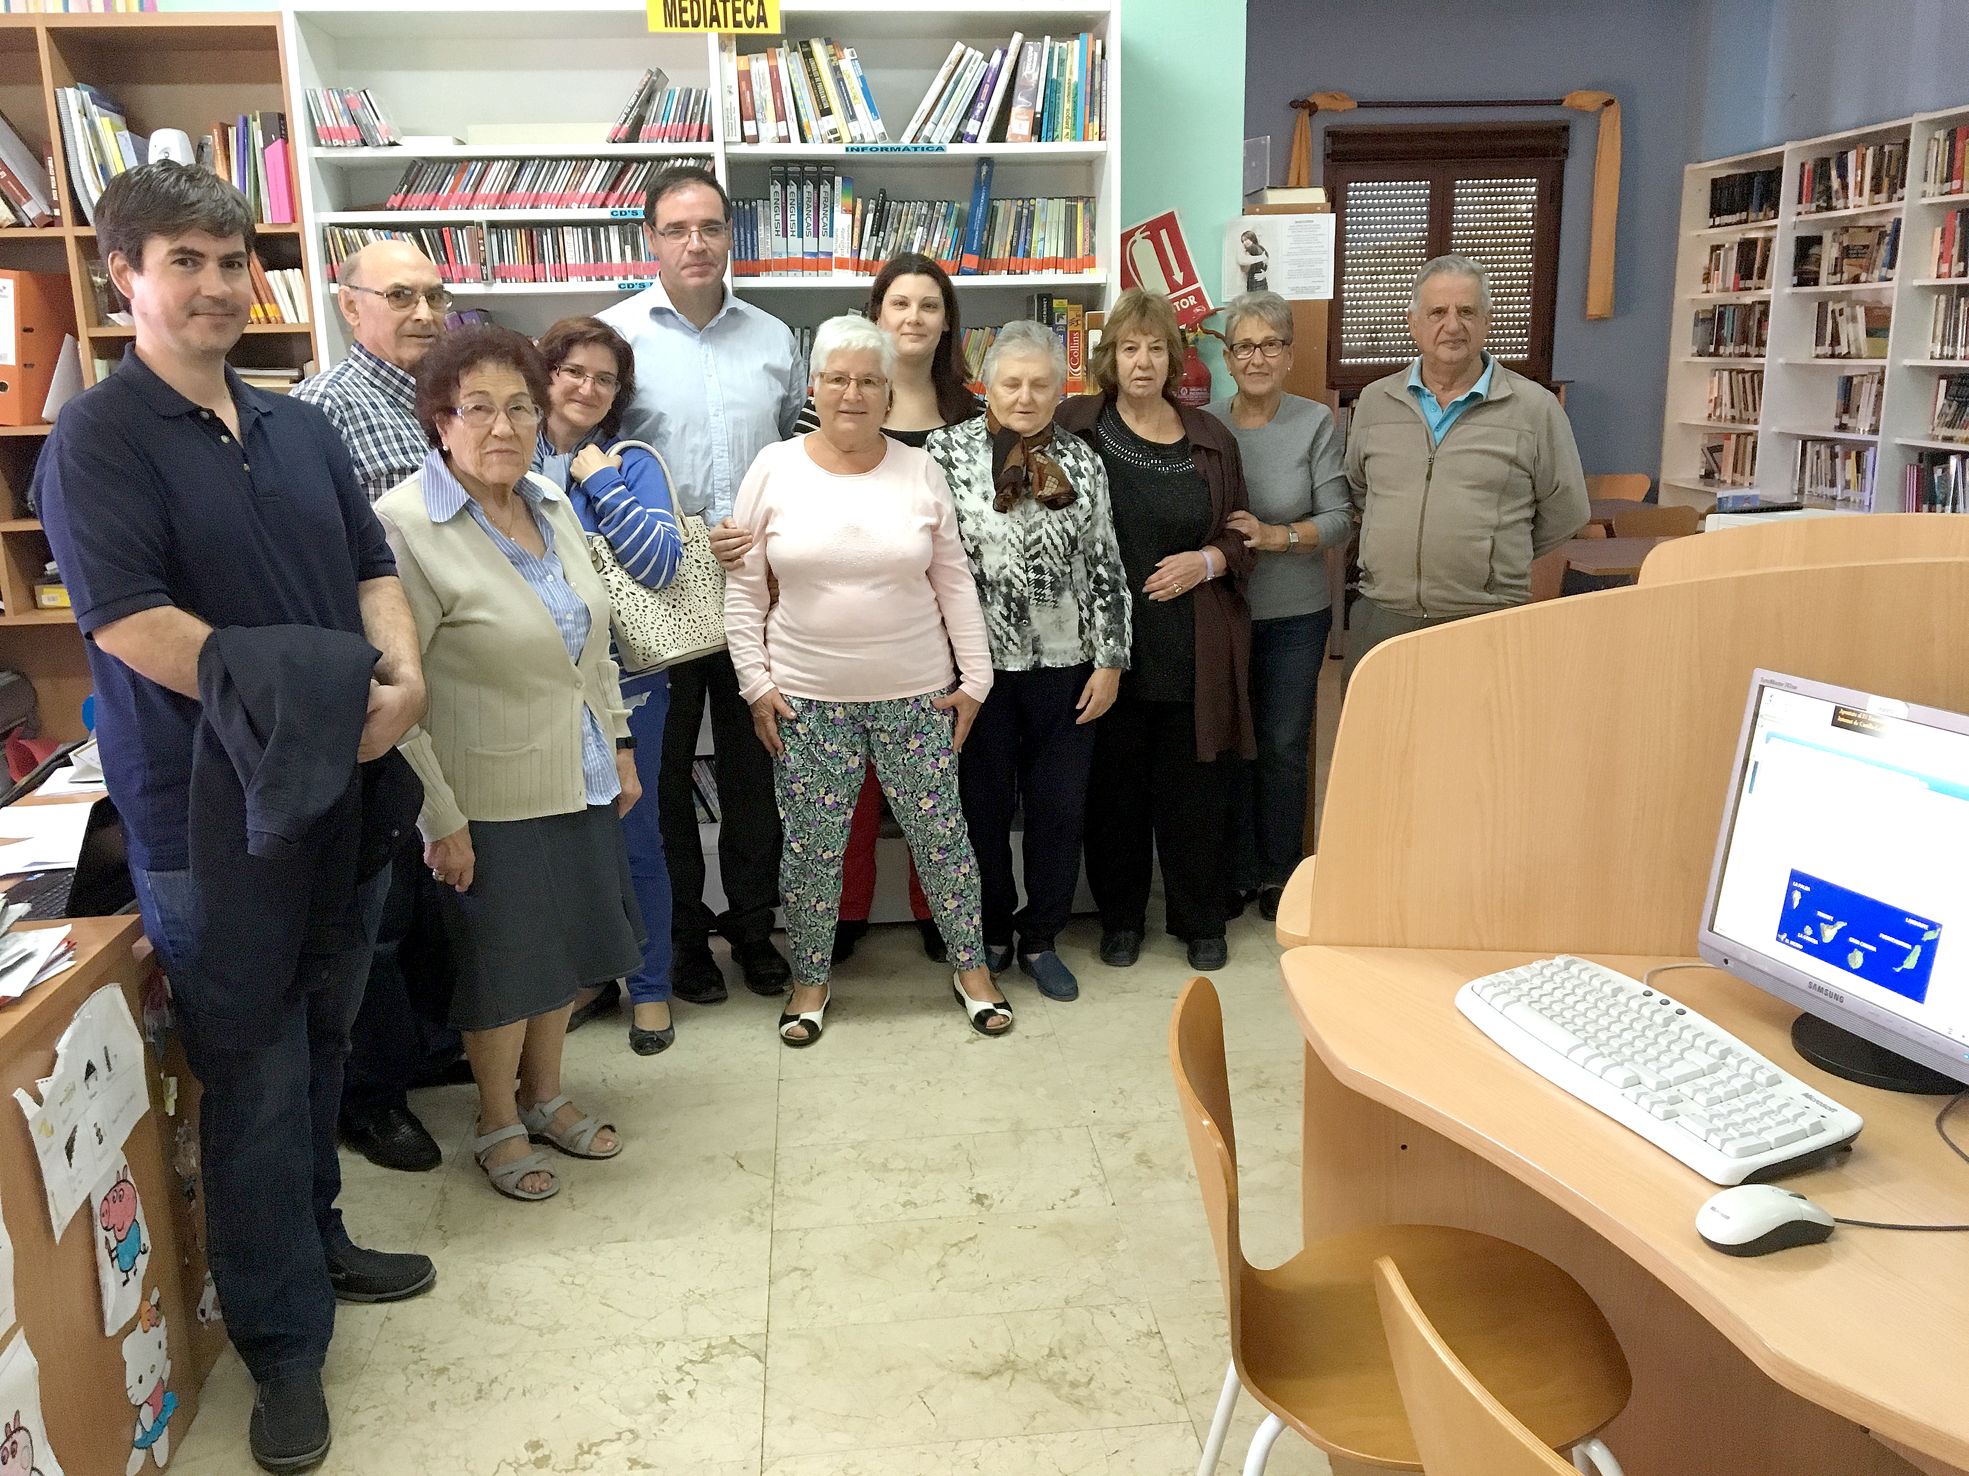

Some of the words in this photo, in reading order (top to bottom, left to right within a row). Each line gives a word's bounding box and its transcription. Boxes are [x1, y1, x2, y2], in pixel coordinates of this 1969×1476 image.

[663, 0, 769, 28] MEDIATECA
[845, 144, 945, 153] INFORMÁTICA
[610, 209, 639, 217] CD'S
[773, 190, 781, 237] ENGLISH
[788, 191, 796, 237] ENGLISH
[805, 190, 813, 237] FRANÇAIS
[821, 190, 829, 237] FRANÇAIS
[618, 282, 646, 290] CD'S
[1173, 295, 1198, 311] TOR
[1070, 332, 1080, 366] Collins
[1808, 981, 1845, 1004] SAMSUNG
[1801, 1092, 1838, 1113] Microsoft
